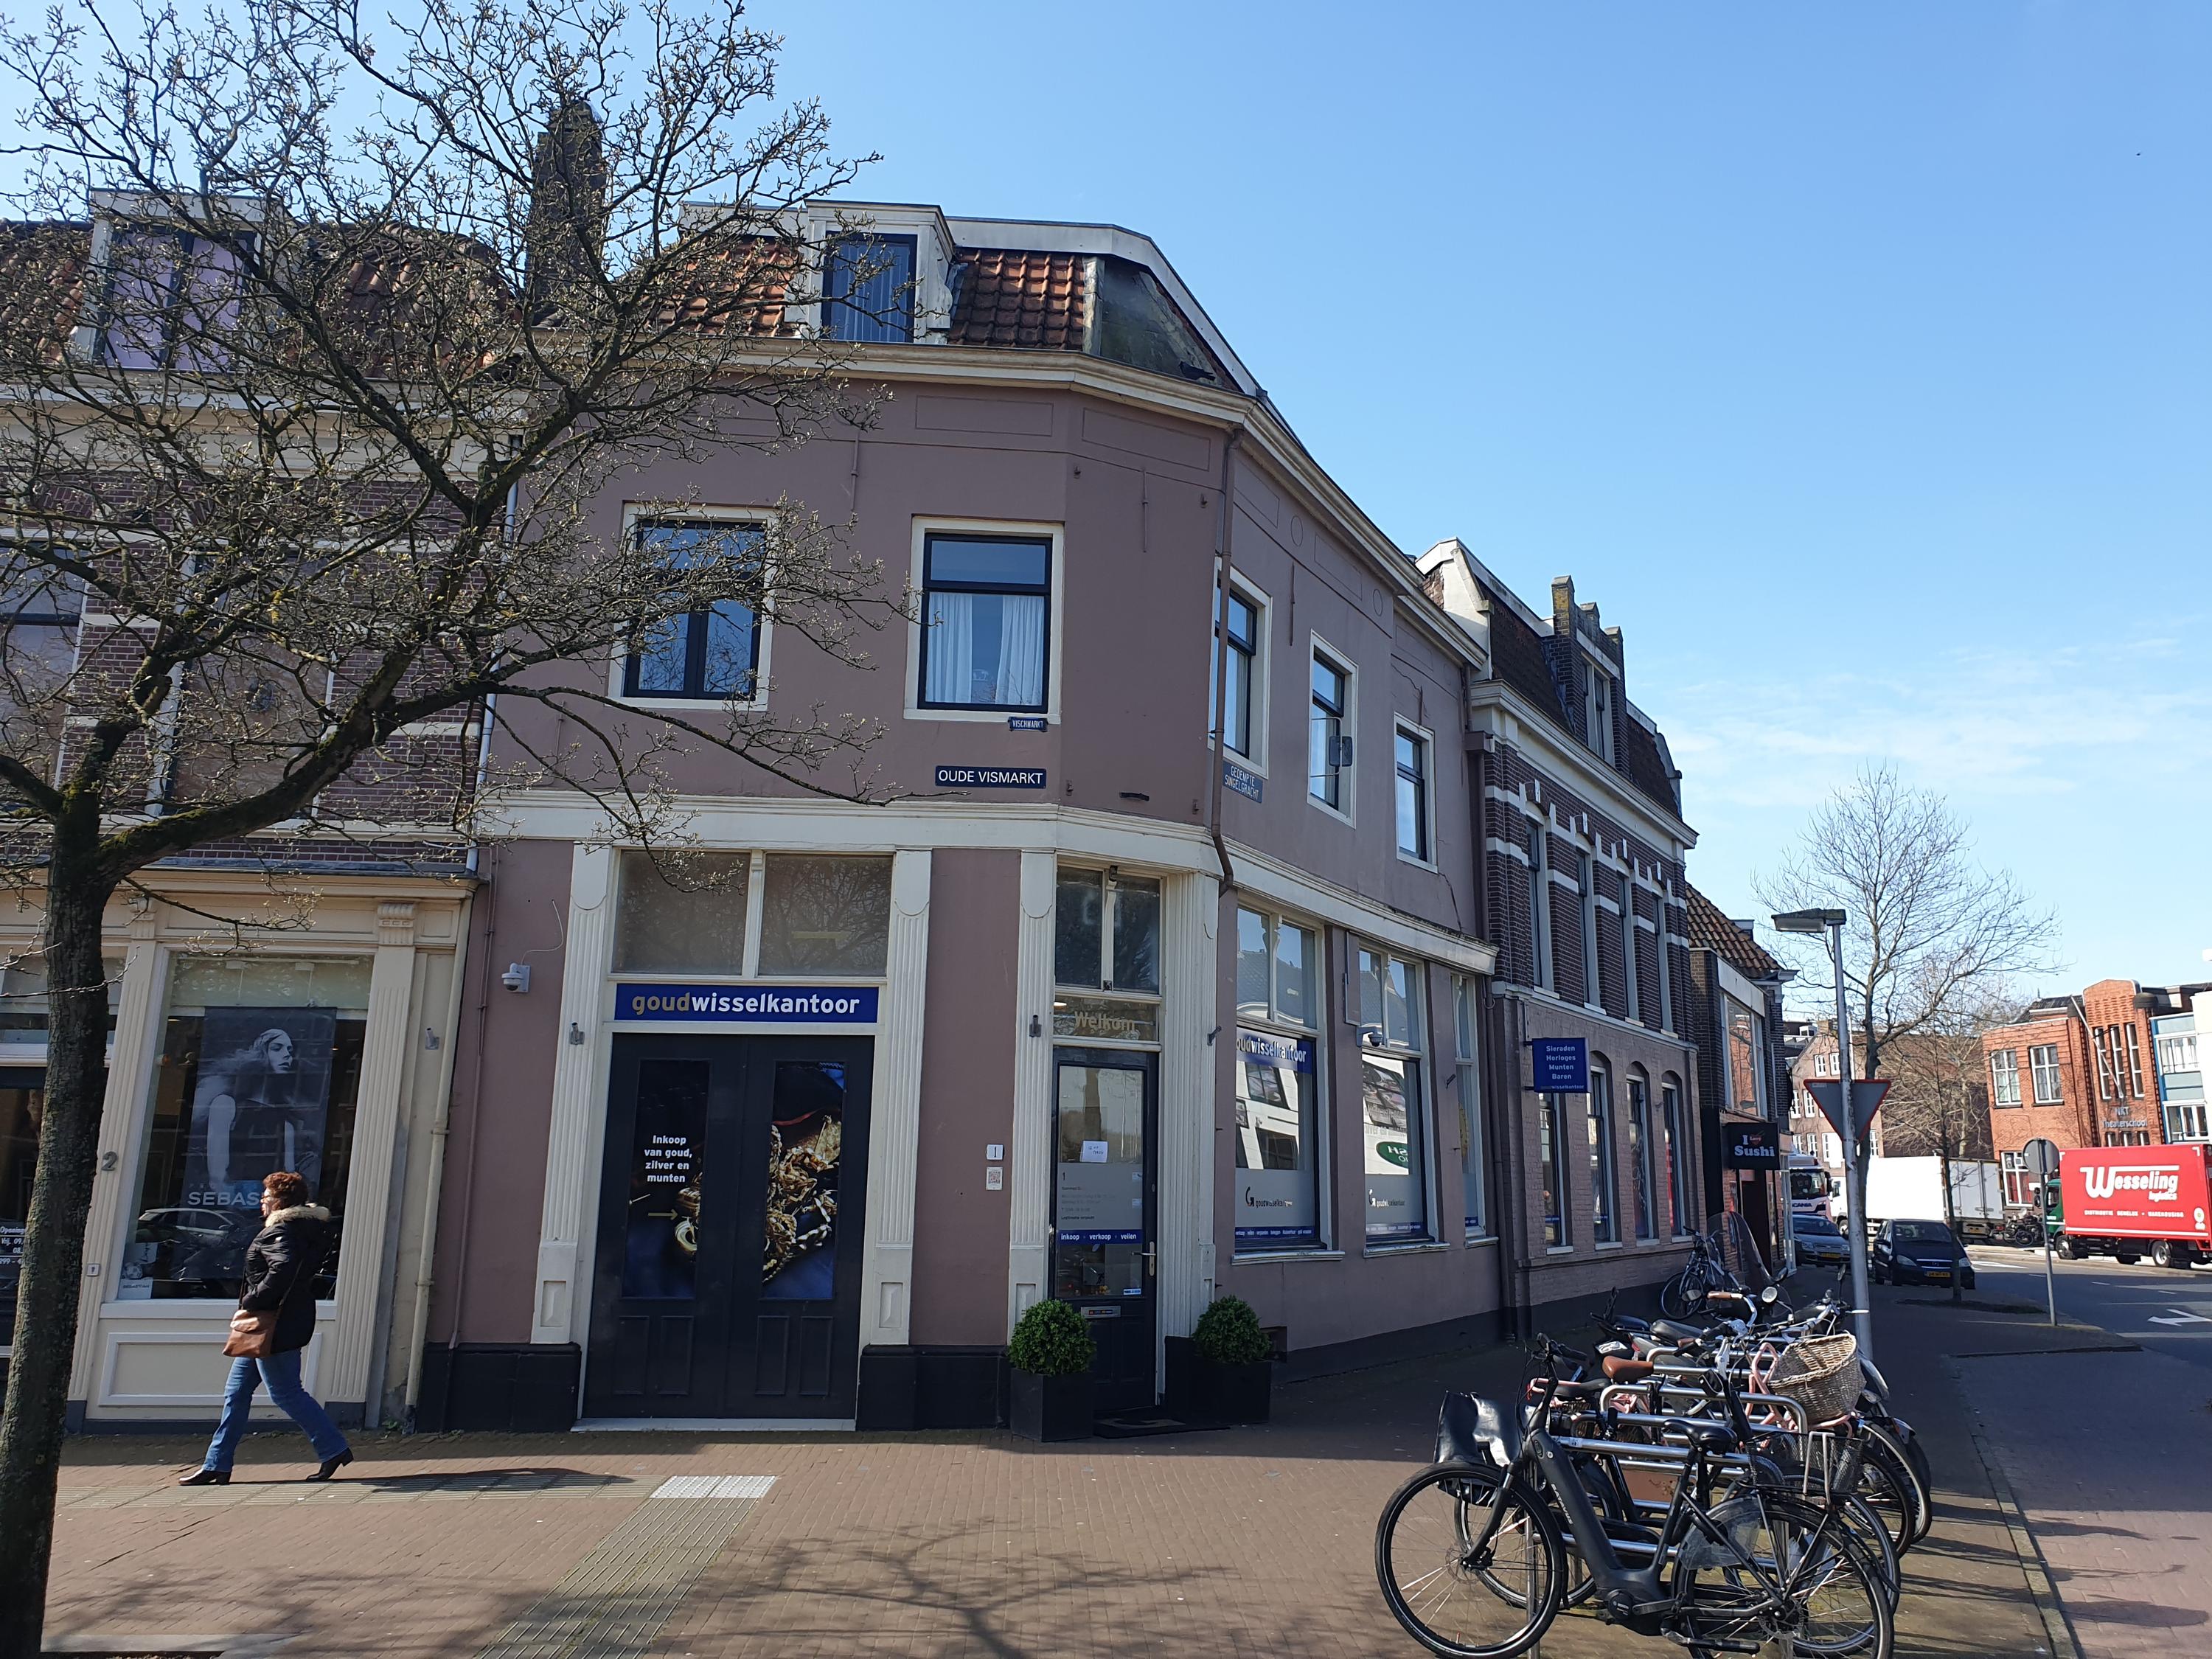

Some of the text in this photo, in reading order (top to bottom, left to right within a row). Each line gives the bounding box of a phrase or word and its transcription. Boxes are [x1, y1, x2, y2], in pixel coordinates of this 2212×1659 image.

[1012, 720, 1043, 728] VISCHMARKT
[939, 770, 1043, 784] OUDE VISMARKT
[1231, 765, 1256, 787] GEDEMPTE
[1225, 774, 1259, 800] SINGELGRACHT
[632, 992, 860, 1015] goudwisselkantoor
[1074, 1011, 1135, 1031] Welkom
[1237, 1037, 1306, 1062] oudwisselkantoor
[653, 1135, 686, 1146] Inkoop
[665, 1148, 692, 1158] goud,
[1734, 1145, 1775, 1157] Sushi
[102, 1152, 118, 1171] 2
[645, 1160, 674, 1169] zilver
[647, 1174, 685, 1182] munten
[2080, 1165, 2179, 1198] Wesseling
[187, 1191, 260, 1206] SEBAS
